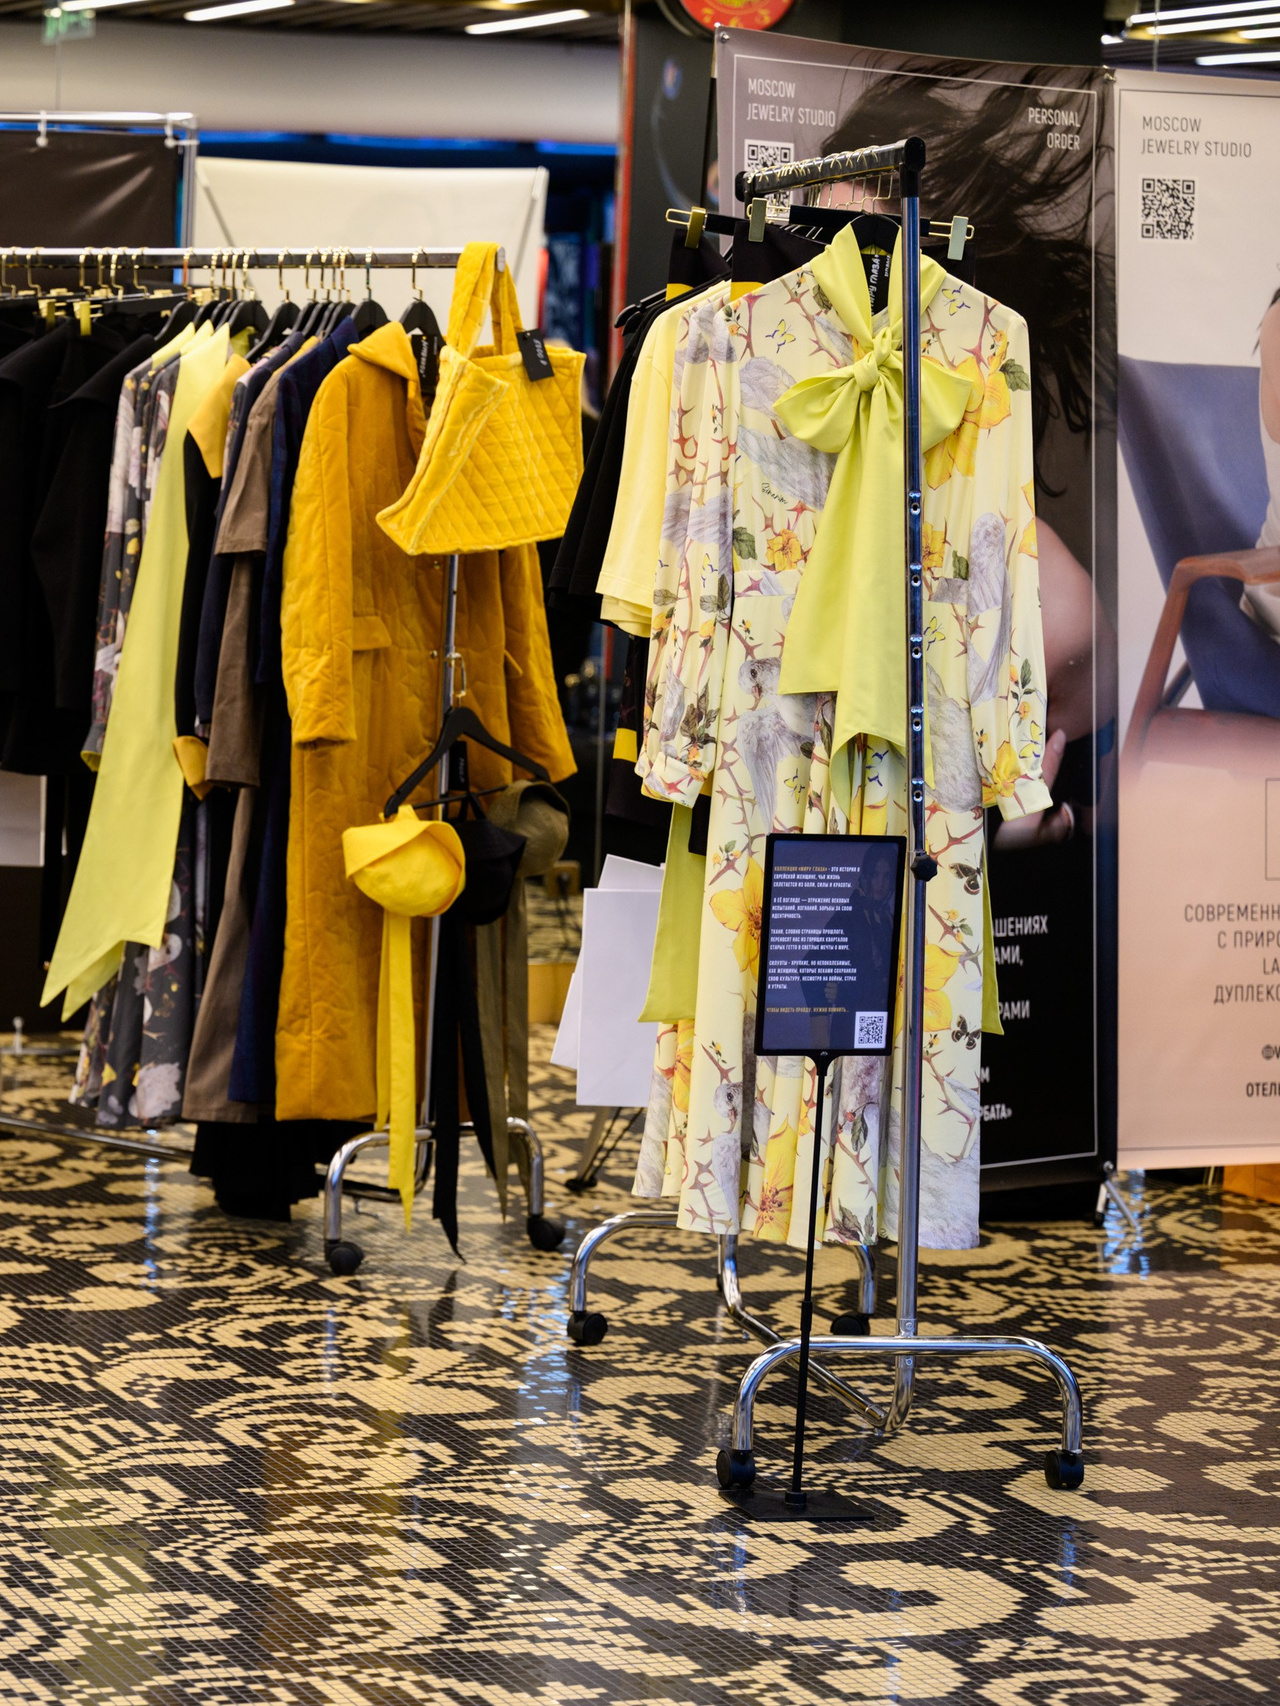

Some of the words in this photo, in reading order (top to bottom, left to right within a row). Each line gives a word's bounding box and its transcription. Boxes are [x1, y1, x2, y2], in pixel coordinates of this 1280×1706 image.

[748, 78, 795, 98] MOSCOW
[746, 103, 794, 123] JEWELRY
[798, 107, 836, 128] STUDIO
[1028, 107, 1081, 128] PERSONAL
[1142, 116, 1202, 132] MOSCOW
[1046, 132, 1080, 151] ORDER
[1141, 138, 1200, 156] JEWELRY
[1205, 142, 1252, 158] STUDIO
[1184, 904, 1280, 922] СОВРЕМЕНН
[993, 914, 1048, 938] ШЕНИЯХ
[1218, 930, 1227, 950] С
